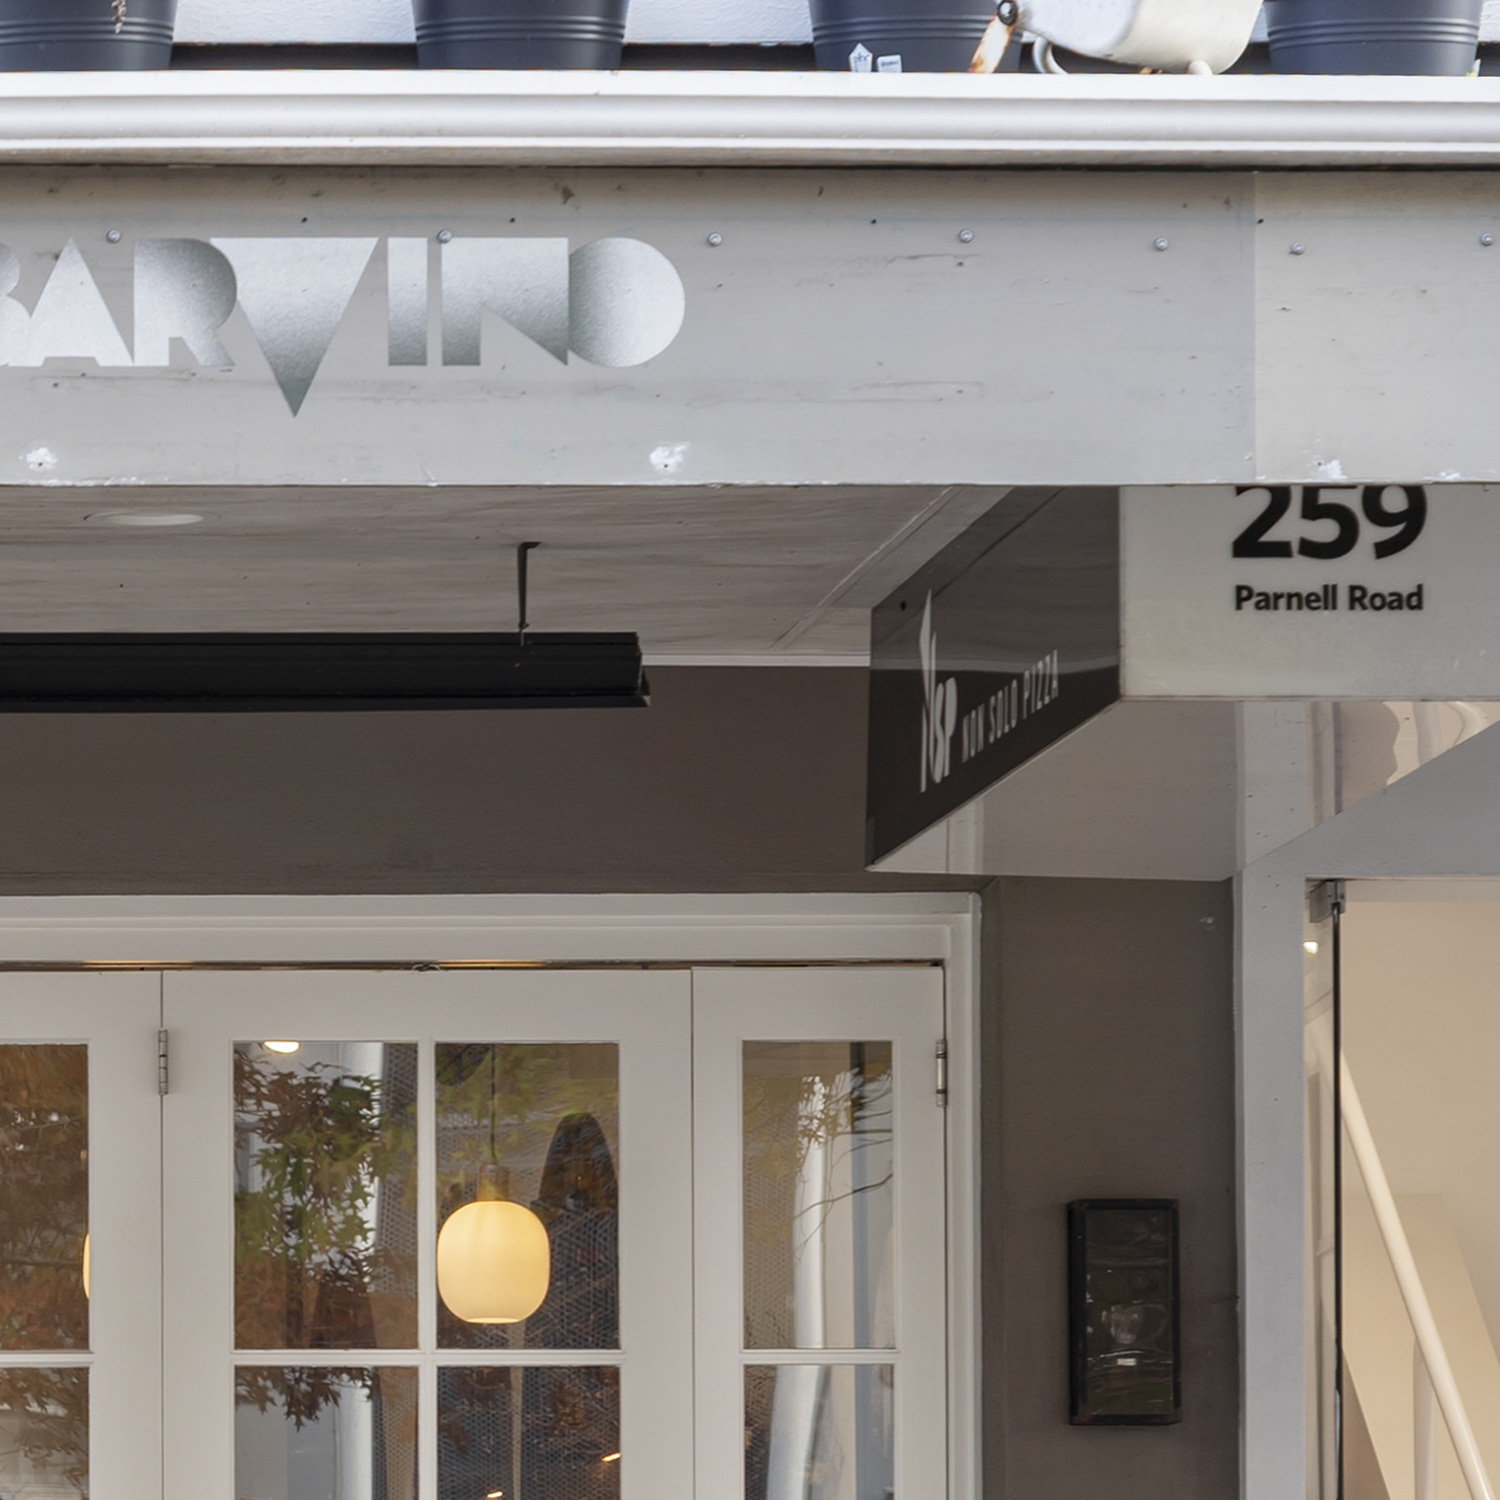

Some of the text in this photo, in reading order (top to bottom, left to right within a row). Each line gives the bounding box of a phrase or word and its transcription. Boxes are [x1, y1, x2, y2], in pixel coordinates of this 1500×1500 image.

[1232, 485, 1427, 560] 259
[1235, 583, 1424, 611] Parnell Road
[962, 649, 1058, 763] NON SOLO PIZZA
